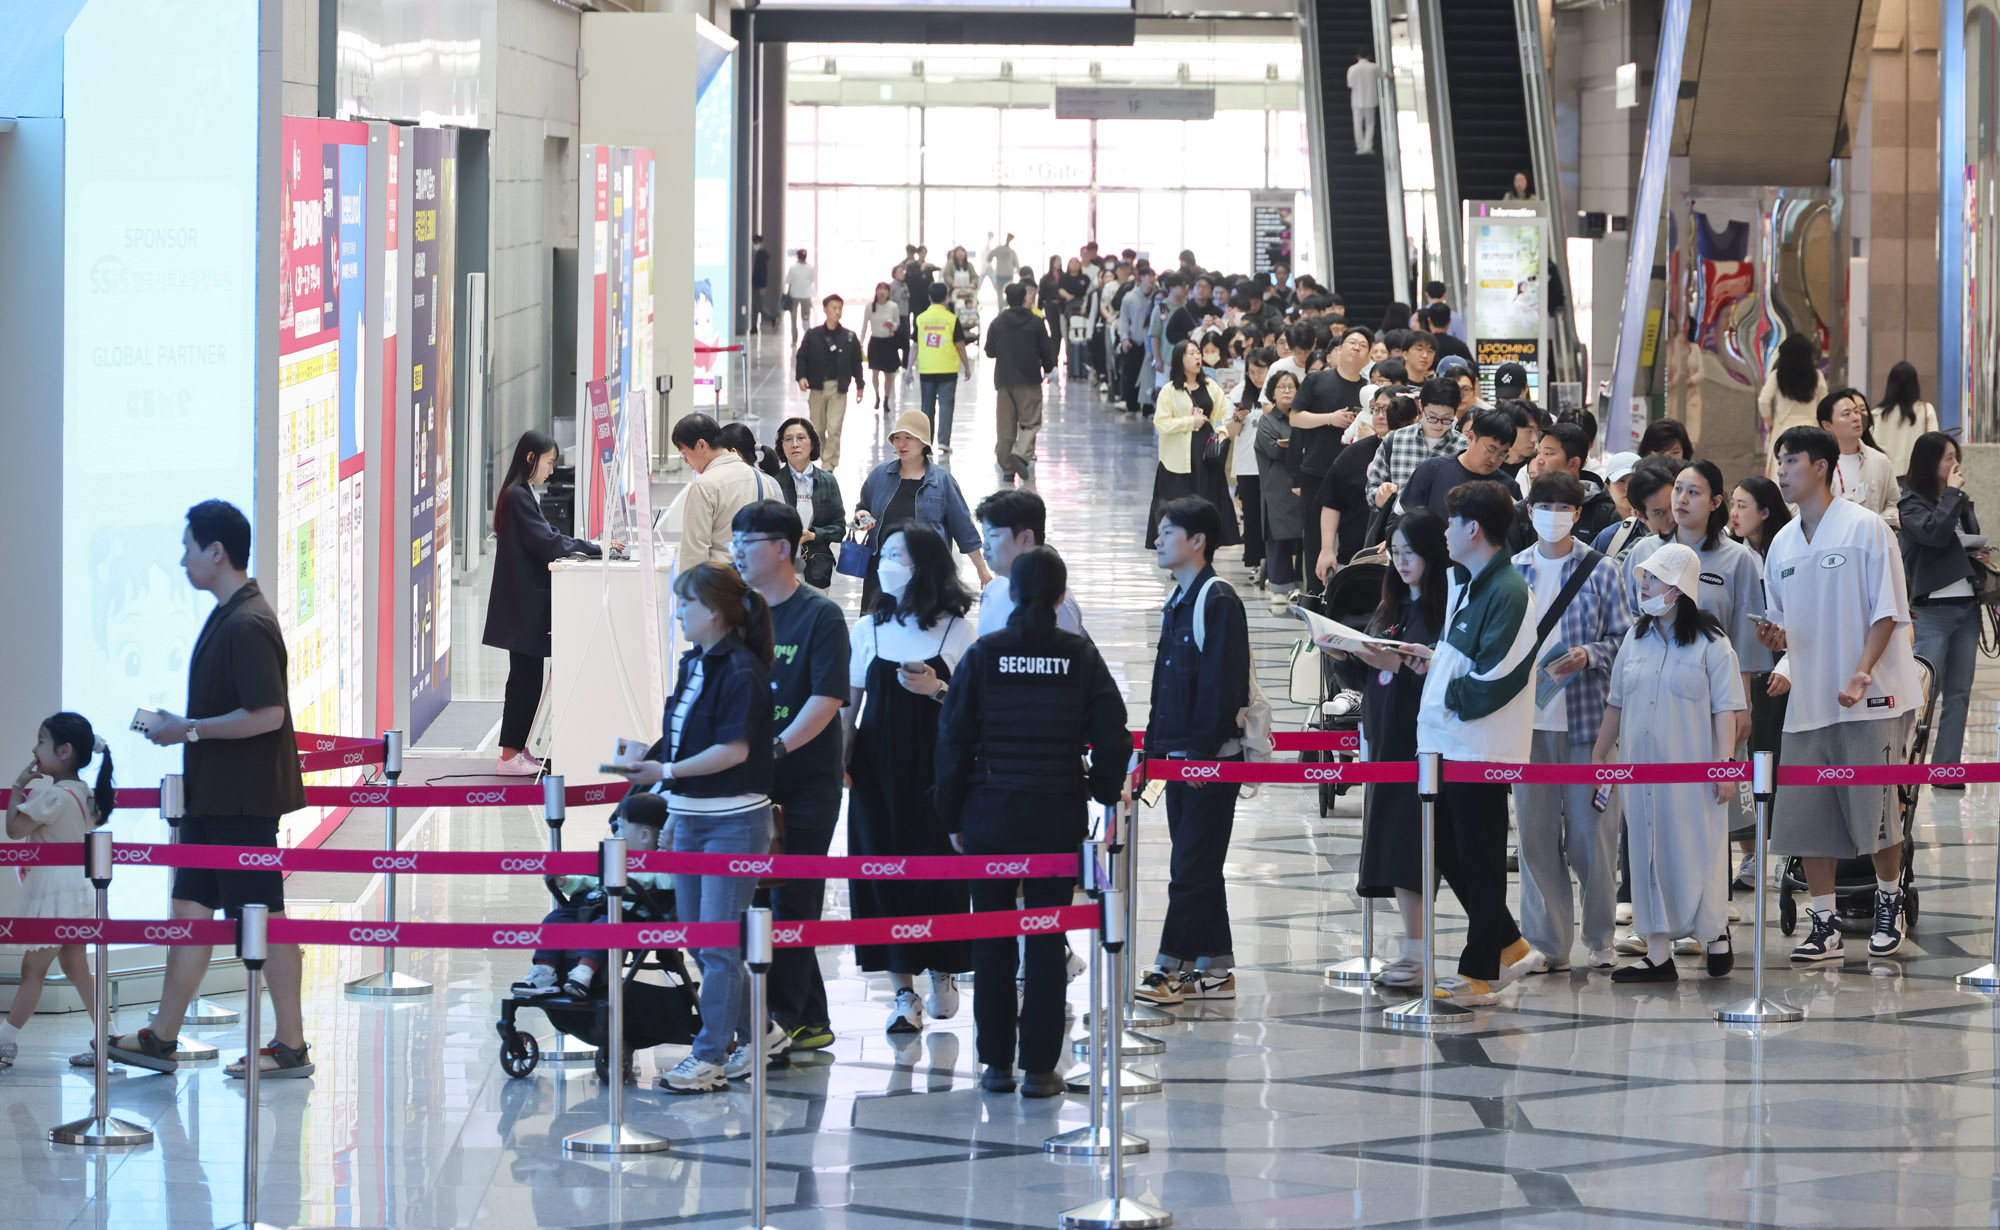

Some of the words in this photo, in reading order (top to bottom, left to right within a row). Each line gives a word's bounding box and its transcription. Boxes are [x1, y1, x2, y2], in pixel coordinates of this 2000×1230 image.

[124, 227, 198, 249] SPONSOR
[92, 346, 153, 368] GLOBAL
[158, 344, 227, 366] PARTNER
[1478, 343, 1536, 354] UPCOMING
[1478, 354, 1520, 365] EVENTS
[998, 656, 1070, 675] SECURITY
[316, 738, 337, 752] coex
[1340, 736, 1359, 747] co
[343, 749, 365, 765] coex
[1181, 763, 1221, 778] coex
[1304, 765, 1343, 781] coex
[1484, 765, 1524, 780] coex
[1595, 765, 1634, 780] coex
[1706, 763, 1746, 779] coex
[1817, 768, 1855, 783] coex
[1927, 766, 1966, 781] coex
[349, 788, 391, 804] coex
[466, 788, 507, 804] coex
[584, 786, 606, 801] coex
[238, 850, 285, 868] coex
[372, 853, 419, 870] coex
[500, 854, 547, 871] coex
[625, 853, 648, 870] ex
[729, 857, 774, 874] coex
[861, 858, 907, 876] coex
[985, 857, 1030, 875] coex
[54, 920, 104, 940] coex
[144, 920, 194, 940] coex
[349, 925, 401, 943] coex
[492, 926, 543, 945] coex
[638, 926, 688, 944] coex
[771, 924, 804, 943] oex
[891, 918, 933, 939] coex
[1019, 910, 1060, 931] coex
